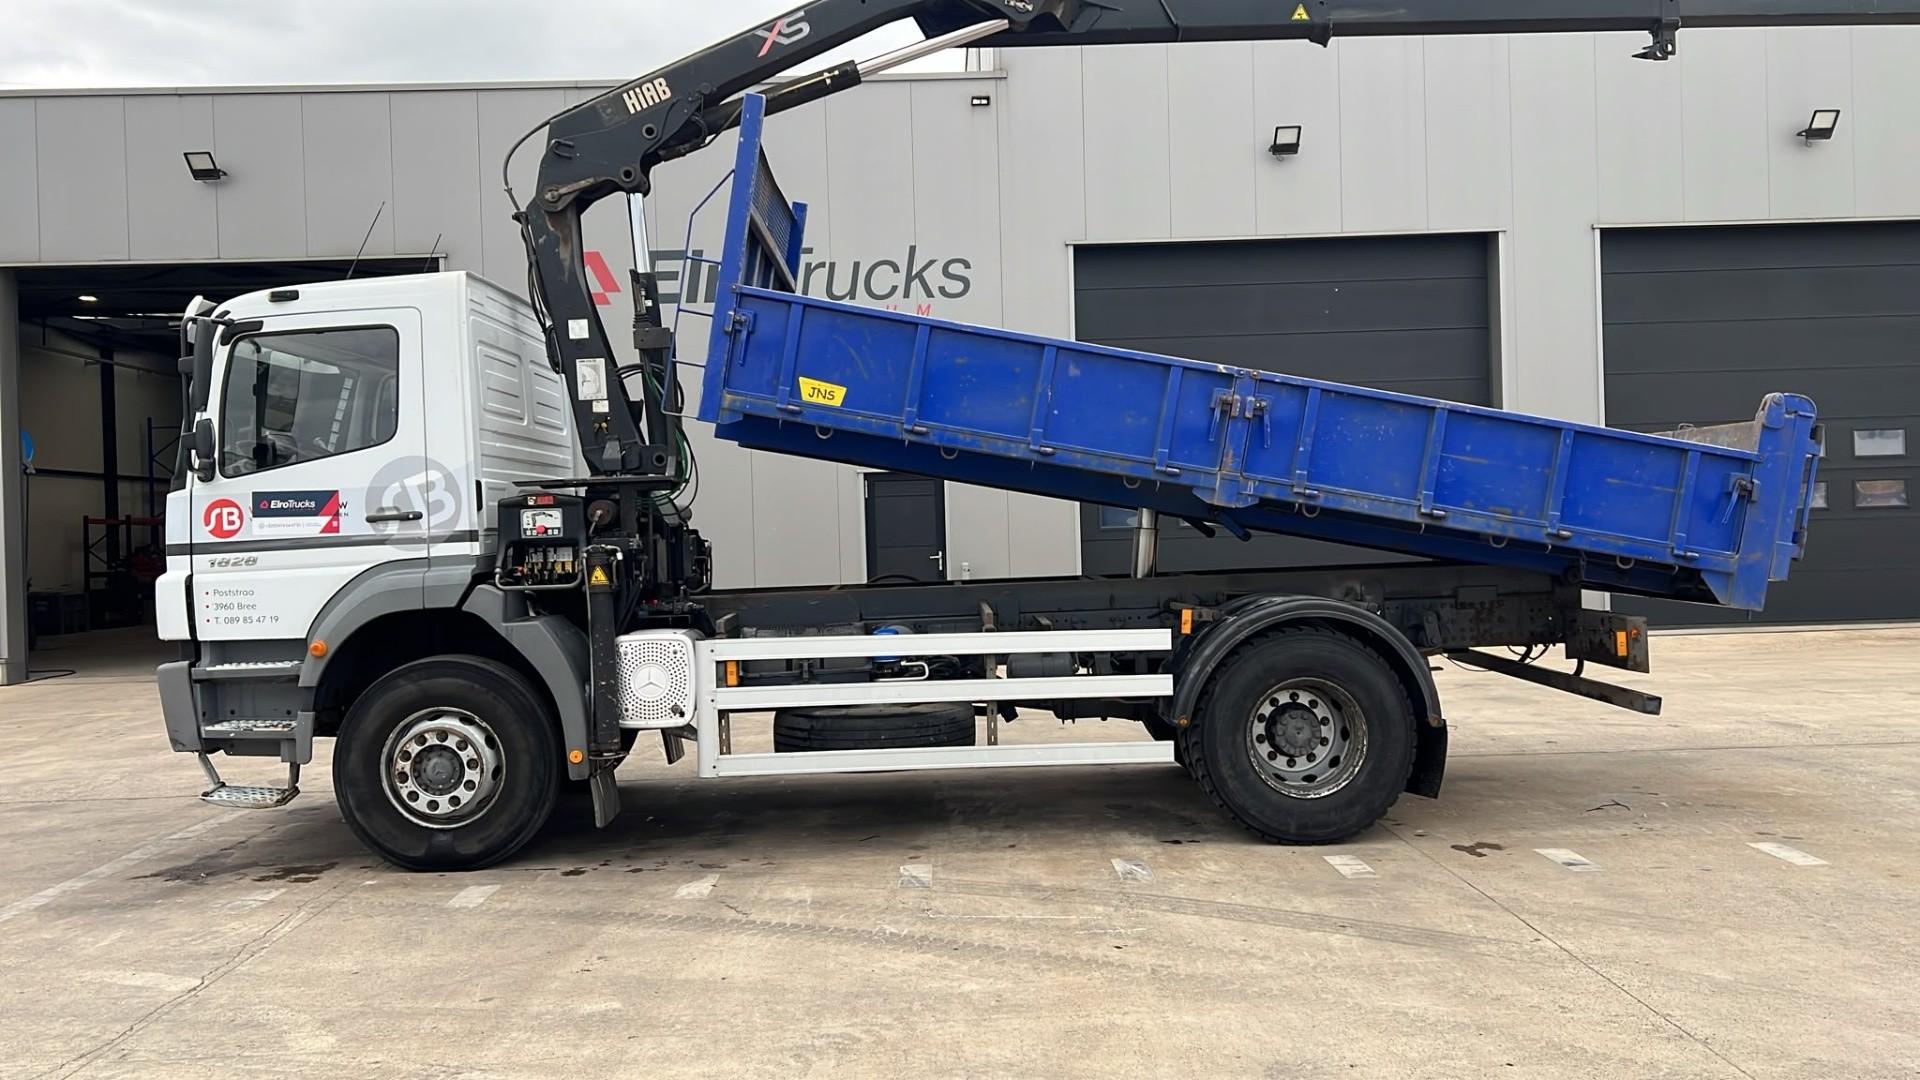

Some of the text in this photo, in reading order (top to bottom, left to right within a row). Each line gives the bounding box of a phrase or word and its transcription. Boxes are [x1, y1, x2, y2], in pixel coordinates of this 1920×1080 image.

[754, 10, 811, 57] XS
[622, 77, 672, 114] HIAB
[808, 387, 835, 401] JNS
[270, 499, 316, 509] ElroTrucks
[204, 507, 241, 531] SB
[208, 556, 258, 568] 1828
[214, 602, 257, 611] 3960 Bree
[223, 616, 240, 625] 089
[242, 616, 254, 624] 85
[256, 615, 267, 623] 47
[270, 615, 279, 623] 19
